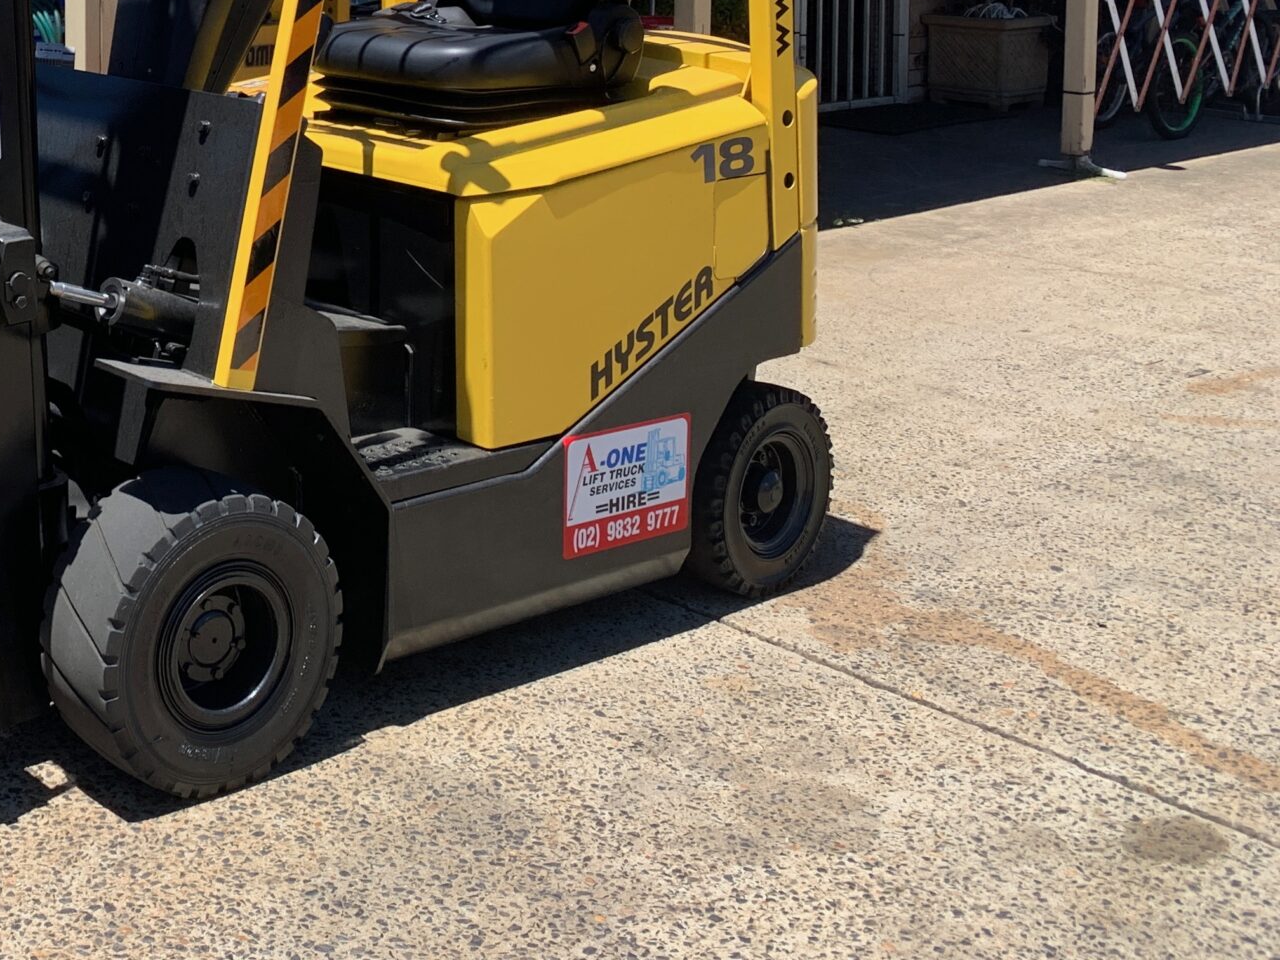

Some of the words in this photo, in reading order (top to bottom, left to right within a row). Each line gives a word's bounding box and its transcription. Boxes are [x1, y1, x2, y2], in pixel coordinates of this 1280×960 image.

[690, 136, 755, 183] 18
[591, 265, 713, 401] HYSTER
[582, 472, 606, 486] LIFT
[609, 463, 645, 480] TRUCK
[589, 478, 636, 496] SERVICES
[573, 523, 600, 553] (02)
[607, 515, 640, 542] 9832
[647, 506, 680, 531] 9777
